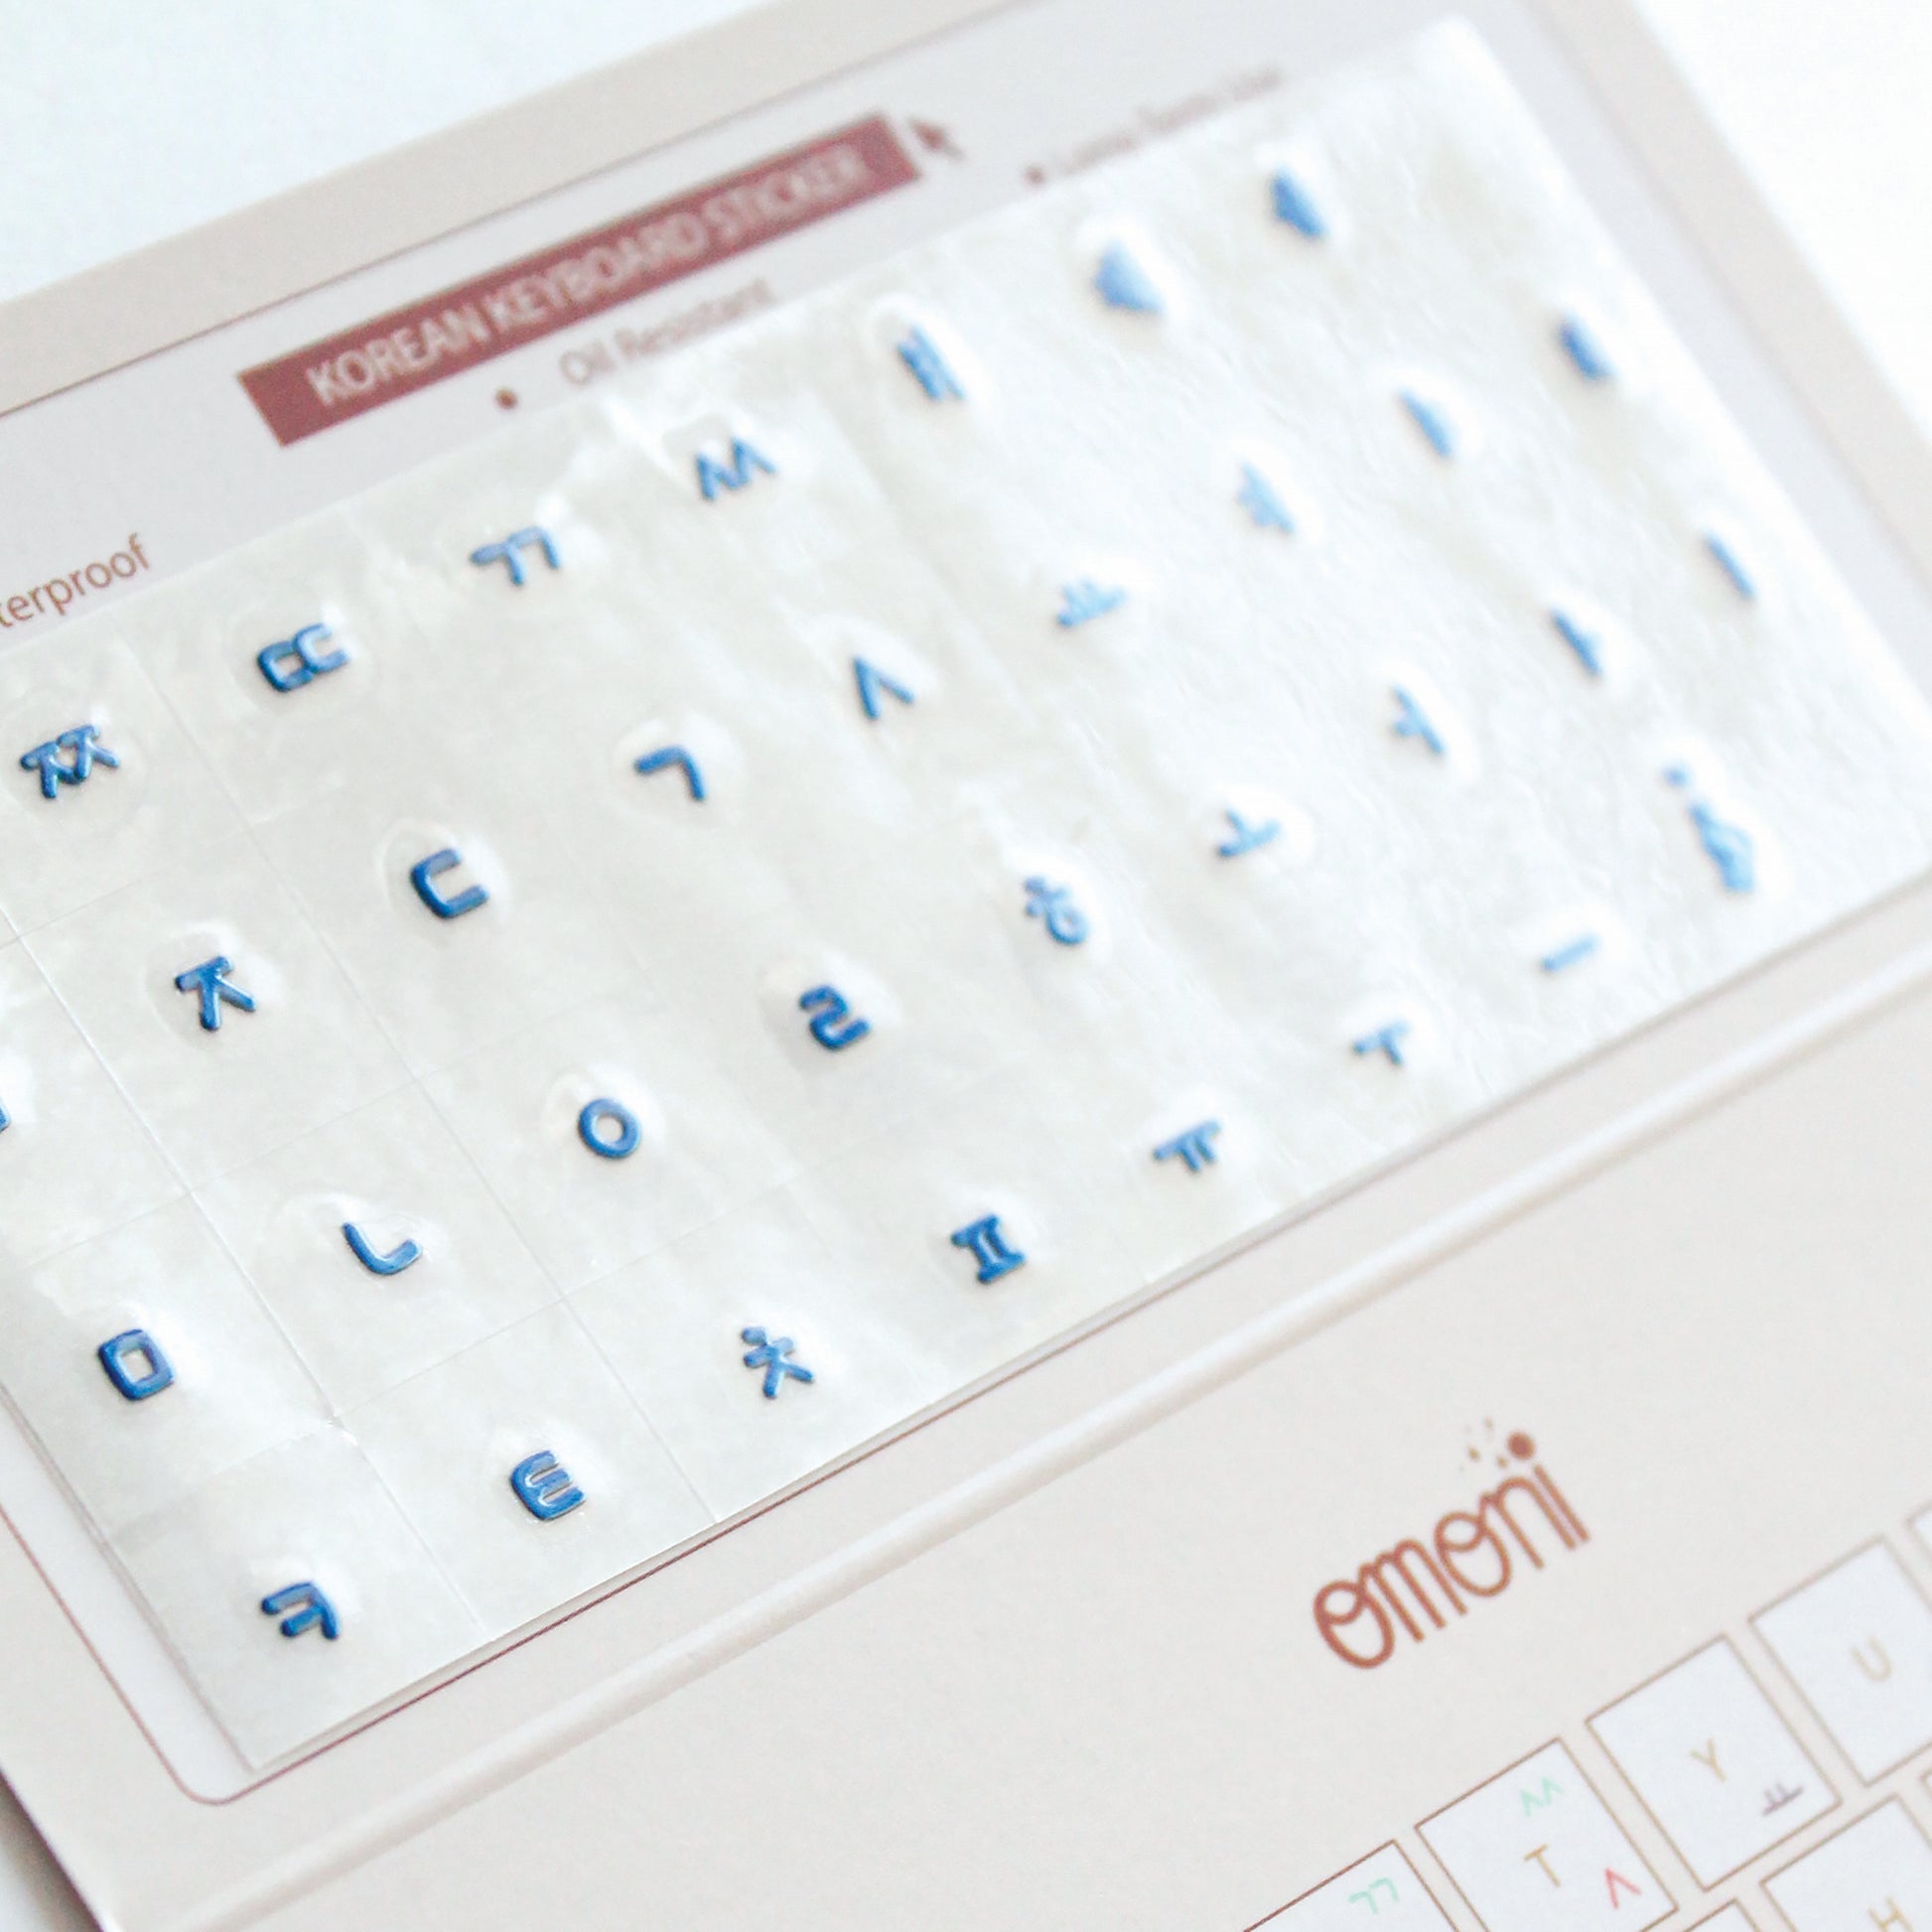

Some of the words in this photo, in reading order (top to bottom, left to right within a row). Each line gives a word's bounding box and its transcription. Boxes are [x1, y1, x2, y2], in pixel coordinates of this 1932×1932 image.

[305, 301, 491, 406] KOREAN
[482, 208, 711, 334] KEYBOARD
[700, 142, 874, 244] STICKER
[559, 335, 617, 386] Oil
[175, 955, 257, 1031] ㅈ
[410, 847, 490, 919] ㄷ
[634, 744, 708, 802] ㄱ
[97, 1326, 177, 1402] ㅁ
[342, 1221, 423, 1276] ㄴ
[798, 983, 874, 1051] ㄹ
[1024, 875, 1090, 947] ㅎ
[261, 1580, 341, 1641] ㅋ
[509, 1449, 588, 1521] ㅌ
[742, 1326, 817, 1399] ㅊ
[949, 1212, 1029, 1285] ㅍ
[1311, 1430, 1592, 1670] omoni
[1524, 1843, 1562, 1888] T
[1691, 1736, 1727, 1783] Y
